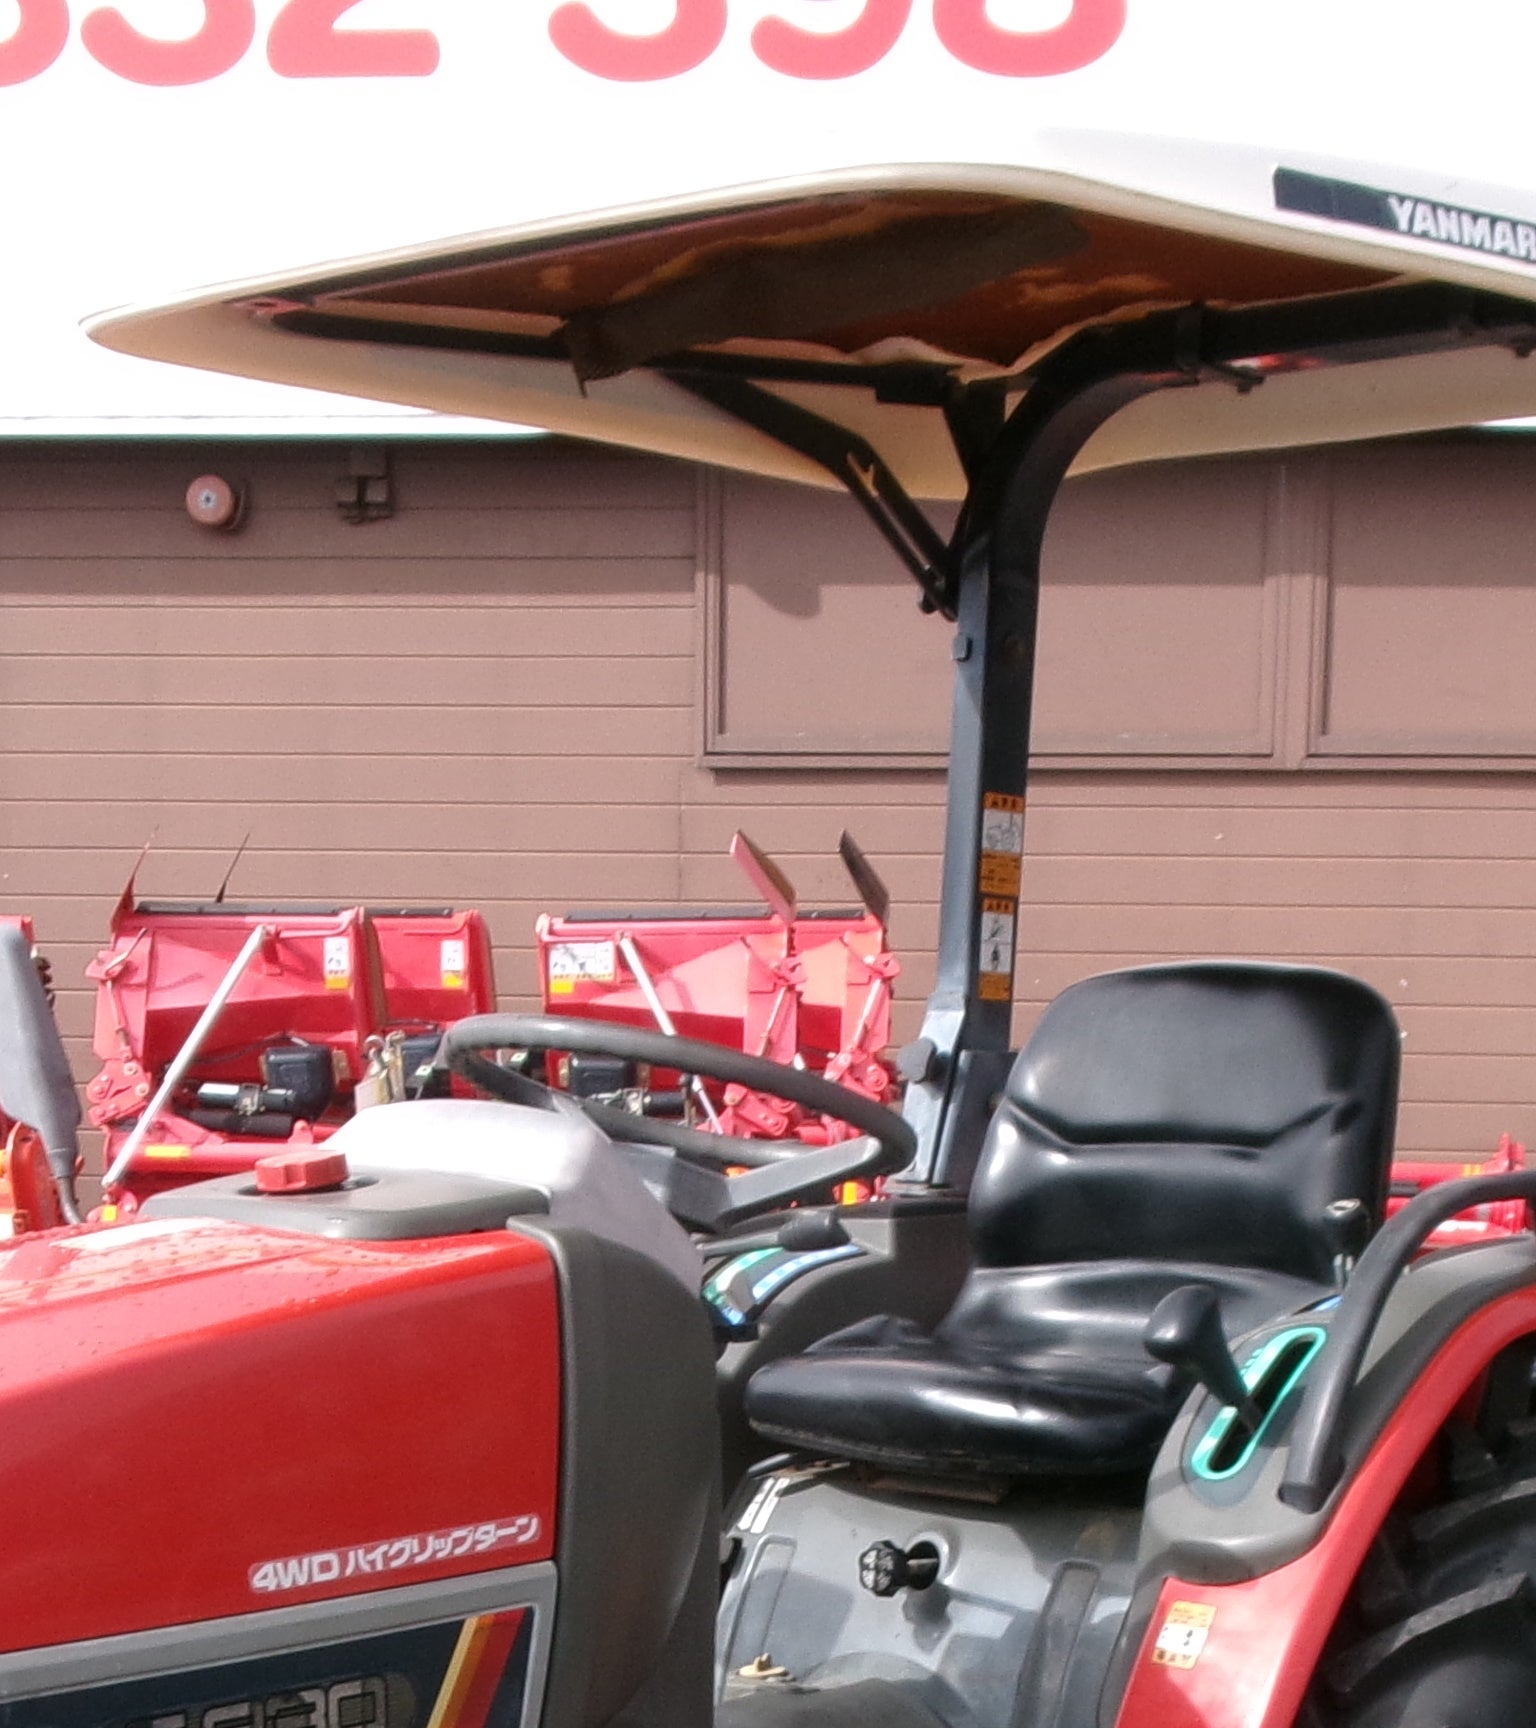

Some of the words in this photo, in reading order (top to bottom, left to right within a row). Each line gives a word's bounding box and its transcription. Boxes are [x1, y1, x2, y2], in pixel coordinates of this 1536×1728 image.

[252, 1552, 341, 1592] 4WD
[345, 1516, 539, 1576] ハイグリップターン
